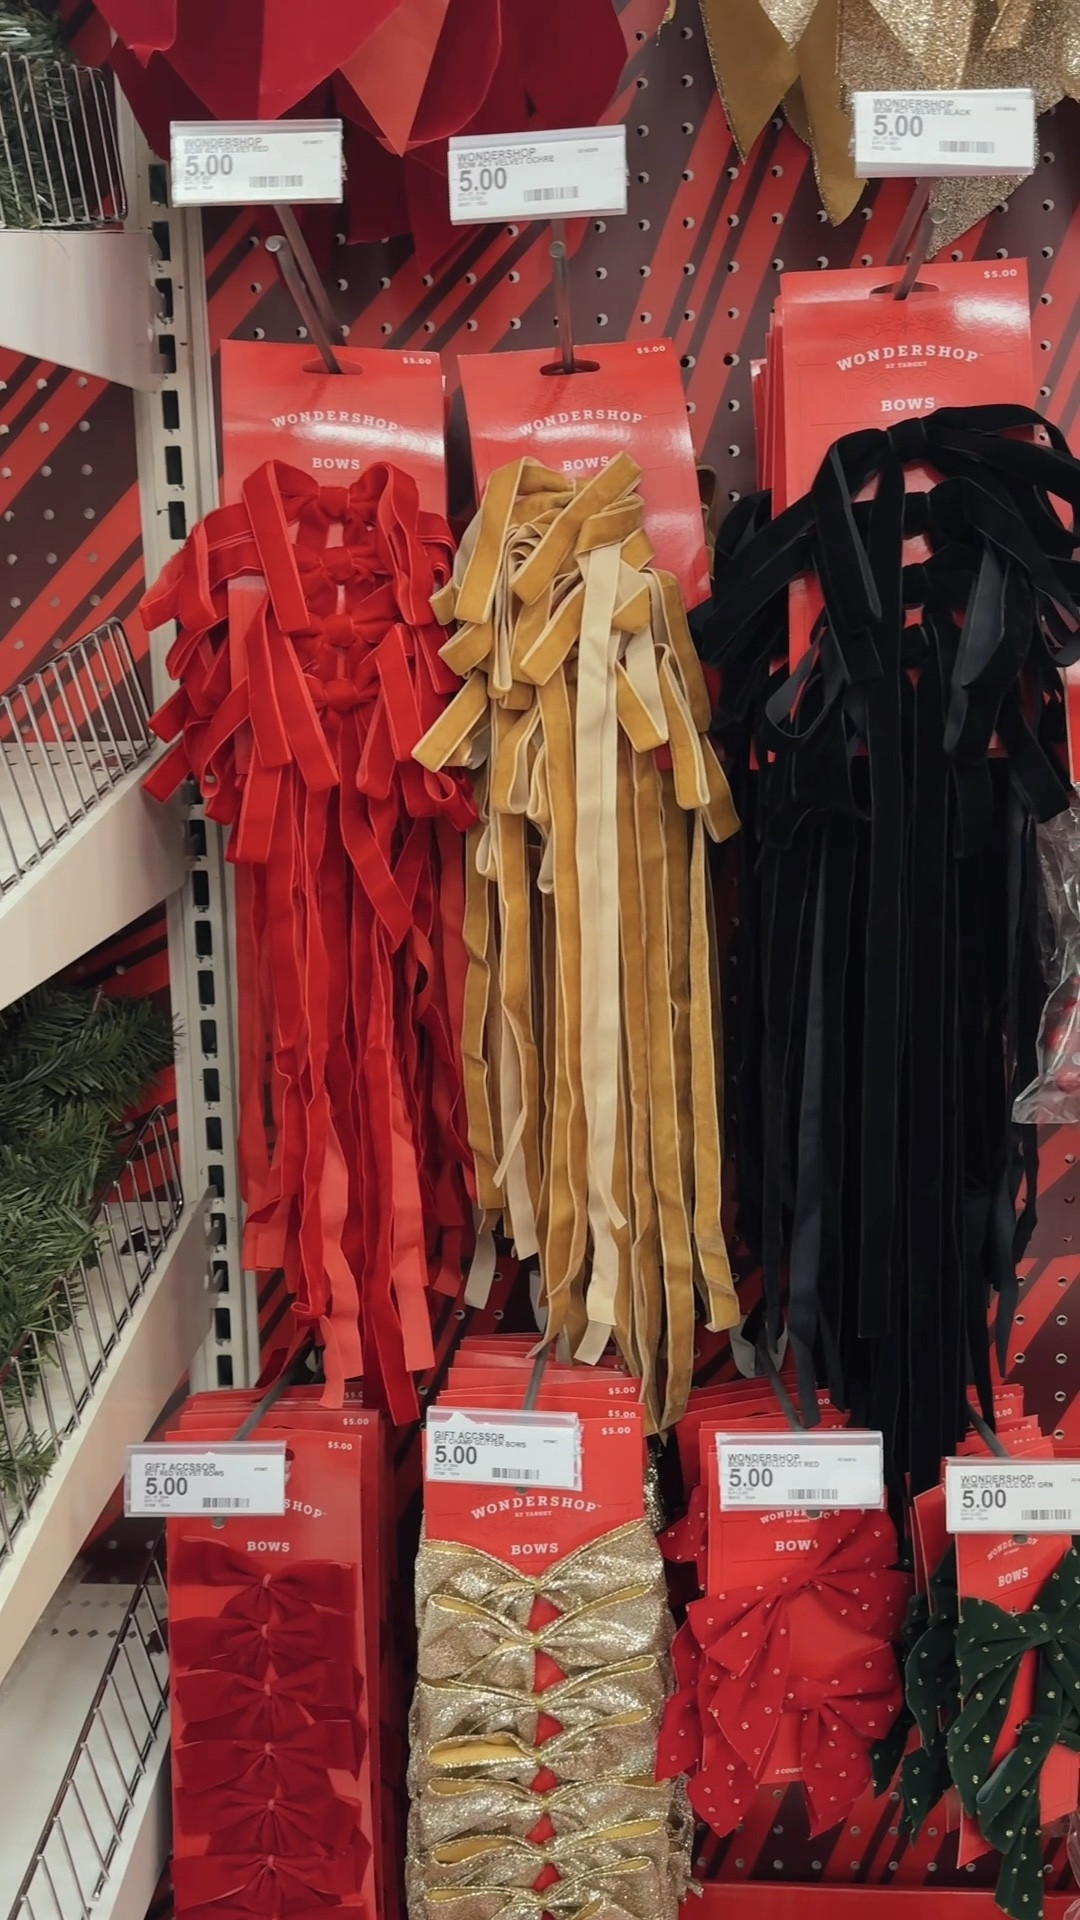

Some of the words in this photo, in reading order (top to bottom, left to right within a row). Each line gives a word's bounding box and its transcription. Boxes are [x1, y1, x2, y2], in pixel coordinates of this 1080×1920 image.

[872, 98, 954, 109] WONDERSHOP
[911, 108, 942, 116] VELVET
[873, 115, 923, 137] 5.00
[184, 137, 263, 148] WONDERSHOP
[457, 147, 536, 162] WONDERSHOP
[185, 154, 233, 176] 5.00
[458, 161, 476, 169] BOW
[495, 157, 525, 167] VELVET
[527, 155, 555, 164] OCHRE
[459, 167, 507, 192] 5.00
[984, 269, 1018, 279] $5.00
[636, 345, 666, 354] $5.00
[836, 344, 979, 372] WONDERSHOP
[880, 397, 935, 412] BOWS
[271, 410, 398, 433] WONDERSHOP
[519, 408, 643, 436] WONDERSHOP
[312, 458, 360, 470] BOWS
[562, 456, 611, 472] BOWS
[608, 1386, 636, 1396] $5.00
[608, 1410, 636, 1419] $5.00
[343, 1418, 369, 1426] $5.00
[434, 1431, 456, 1440] GIFT
[459, 1431, 505, 1441] ACCSSOR
[601, 1426, 631, 1436] $5.00
[328, 1441, 353, 1450] $5.00
[434, 1445, 478, 1464] 5.00
[728, 1453, 800, 1462] WONDERSHOP
[144, 1462, 167, 1471] GIFT
[169, 1462, 216, 1471] ACCSSOR
[729, 1468, 774, 1487] 5.00
[961, 1474, 1034, 1484] WONDERSHOP
[145, 1477, 188, 1496] 5.00
[962, 1489, 1007, 1508] 5.00
[471, 1495, 597, 1520] WONDERSHOP
[247, 1541, 290, 1553] BOWS
[511, 1543, 559, 1556] BOWS
[998, 1567, 1029, 1587] BOWS
